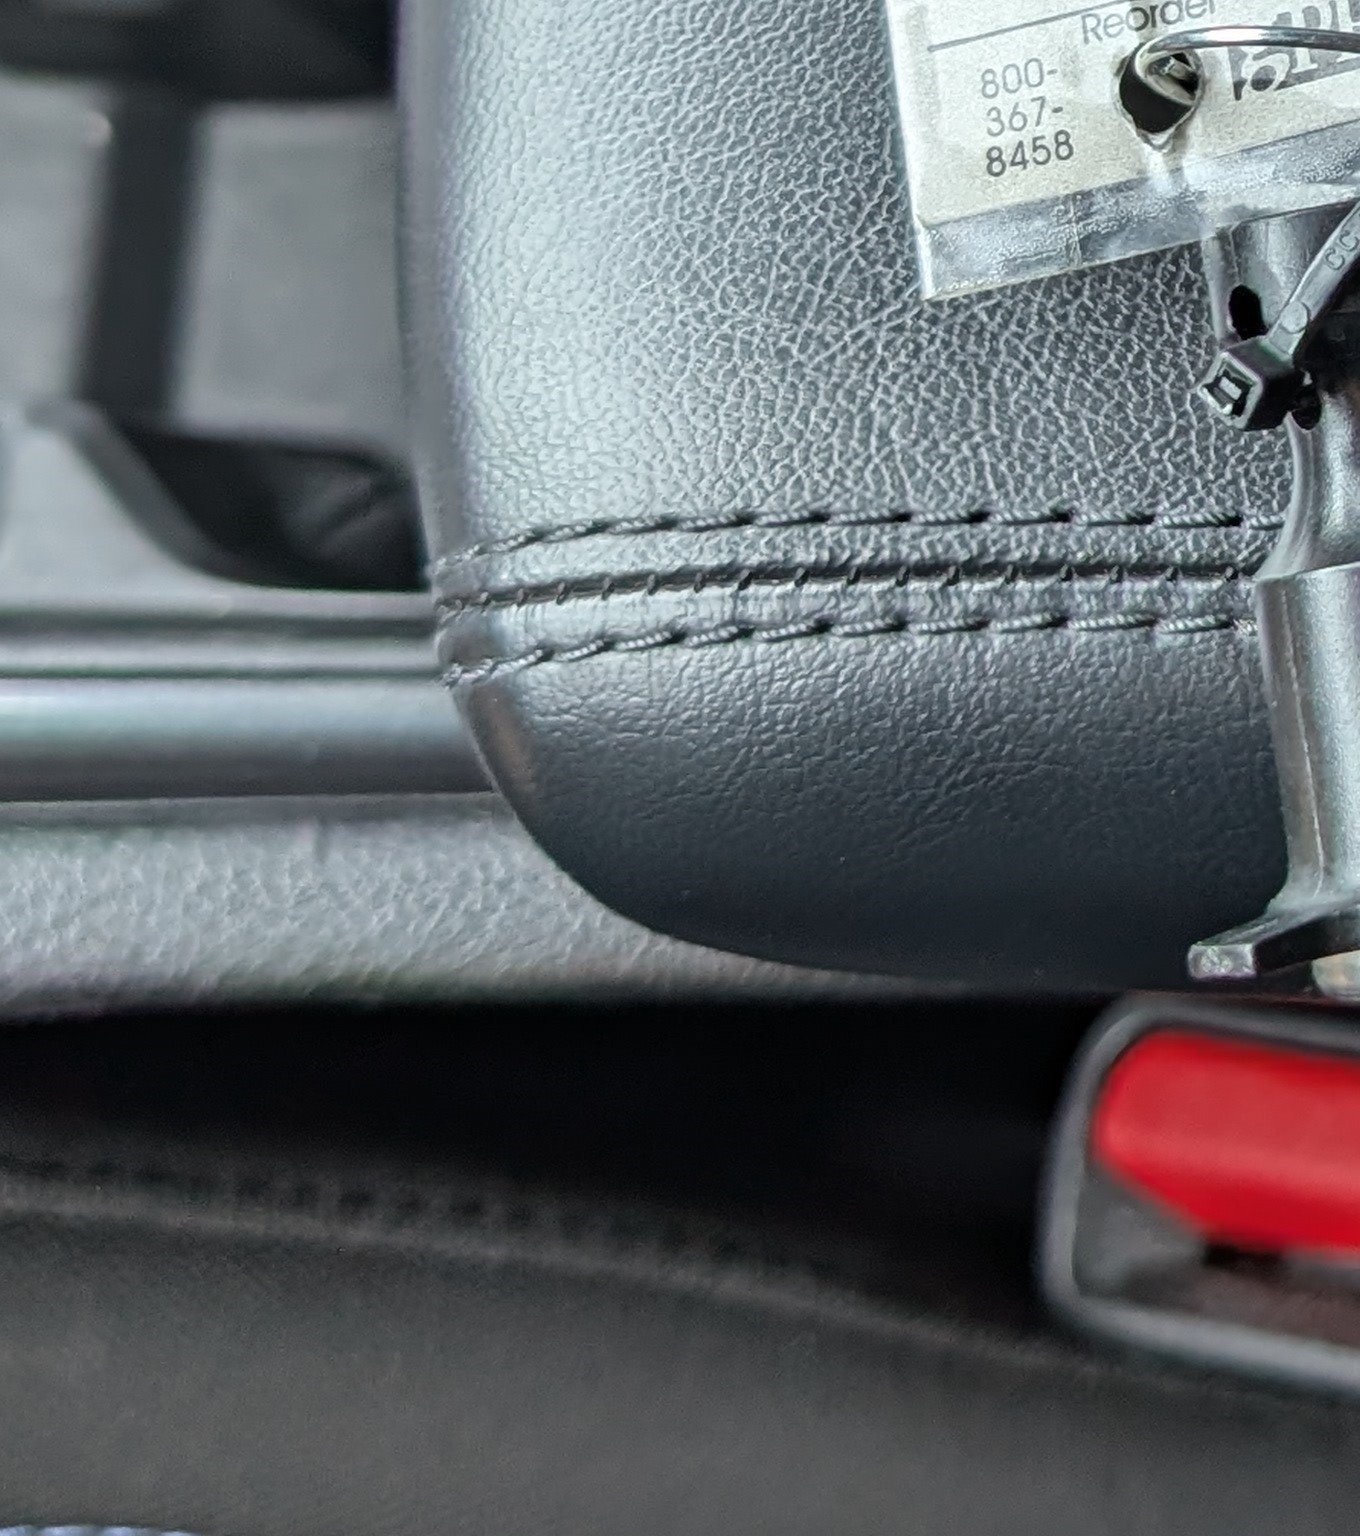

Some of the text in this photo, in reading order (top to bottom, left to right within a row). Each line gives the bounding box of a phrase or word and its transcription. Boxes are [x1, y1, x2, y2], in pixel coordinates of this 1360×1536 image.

[980, 57, 1059, 100] 800-
[985, 95, 1064, 138] 367-
[985, 130, 1075, 178] 8458
